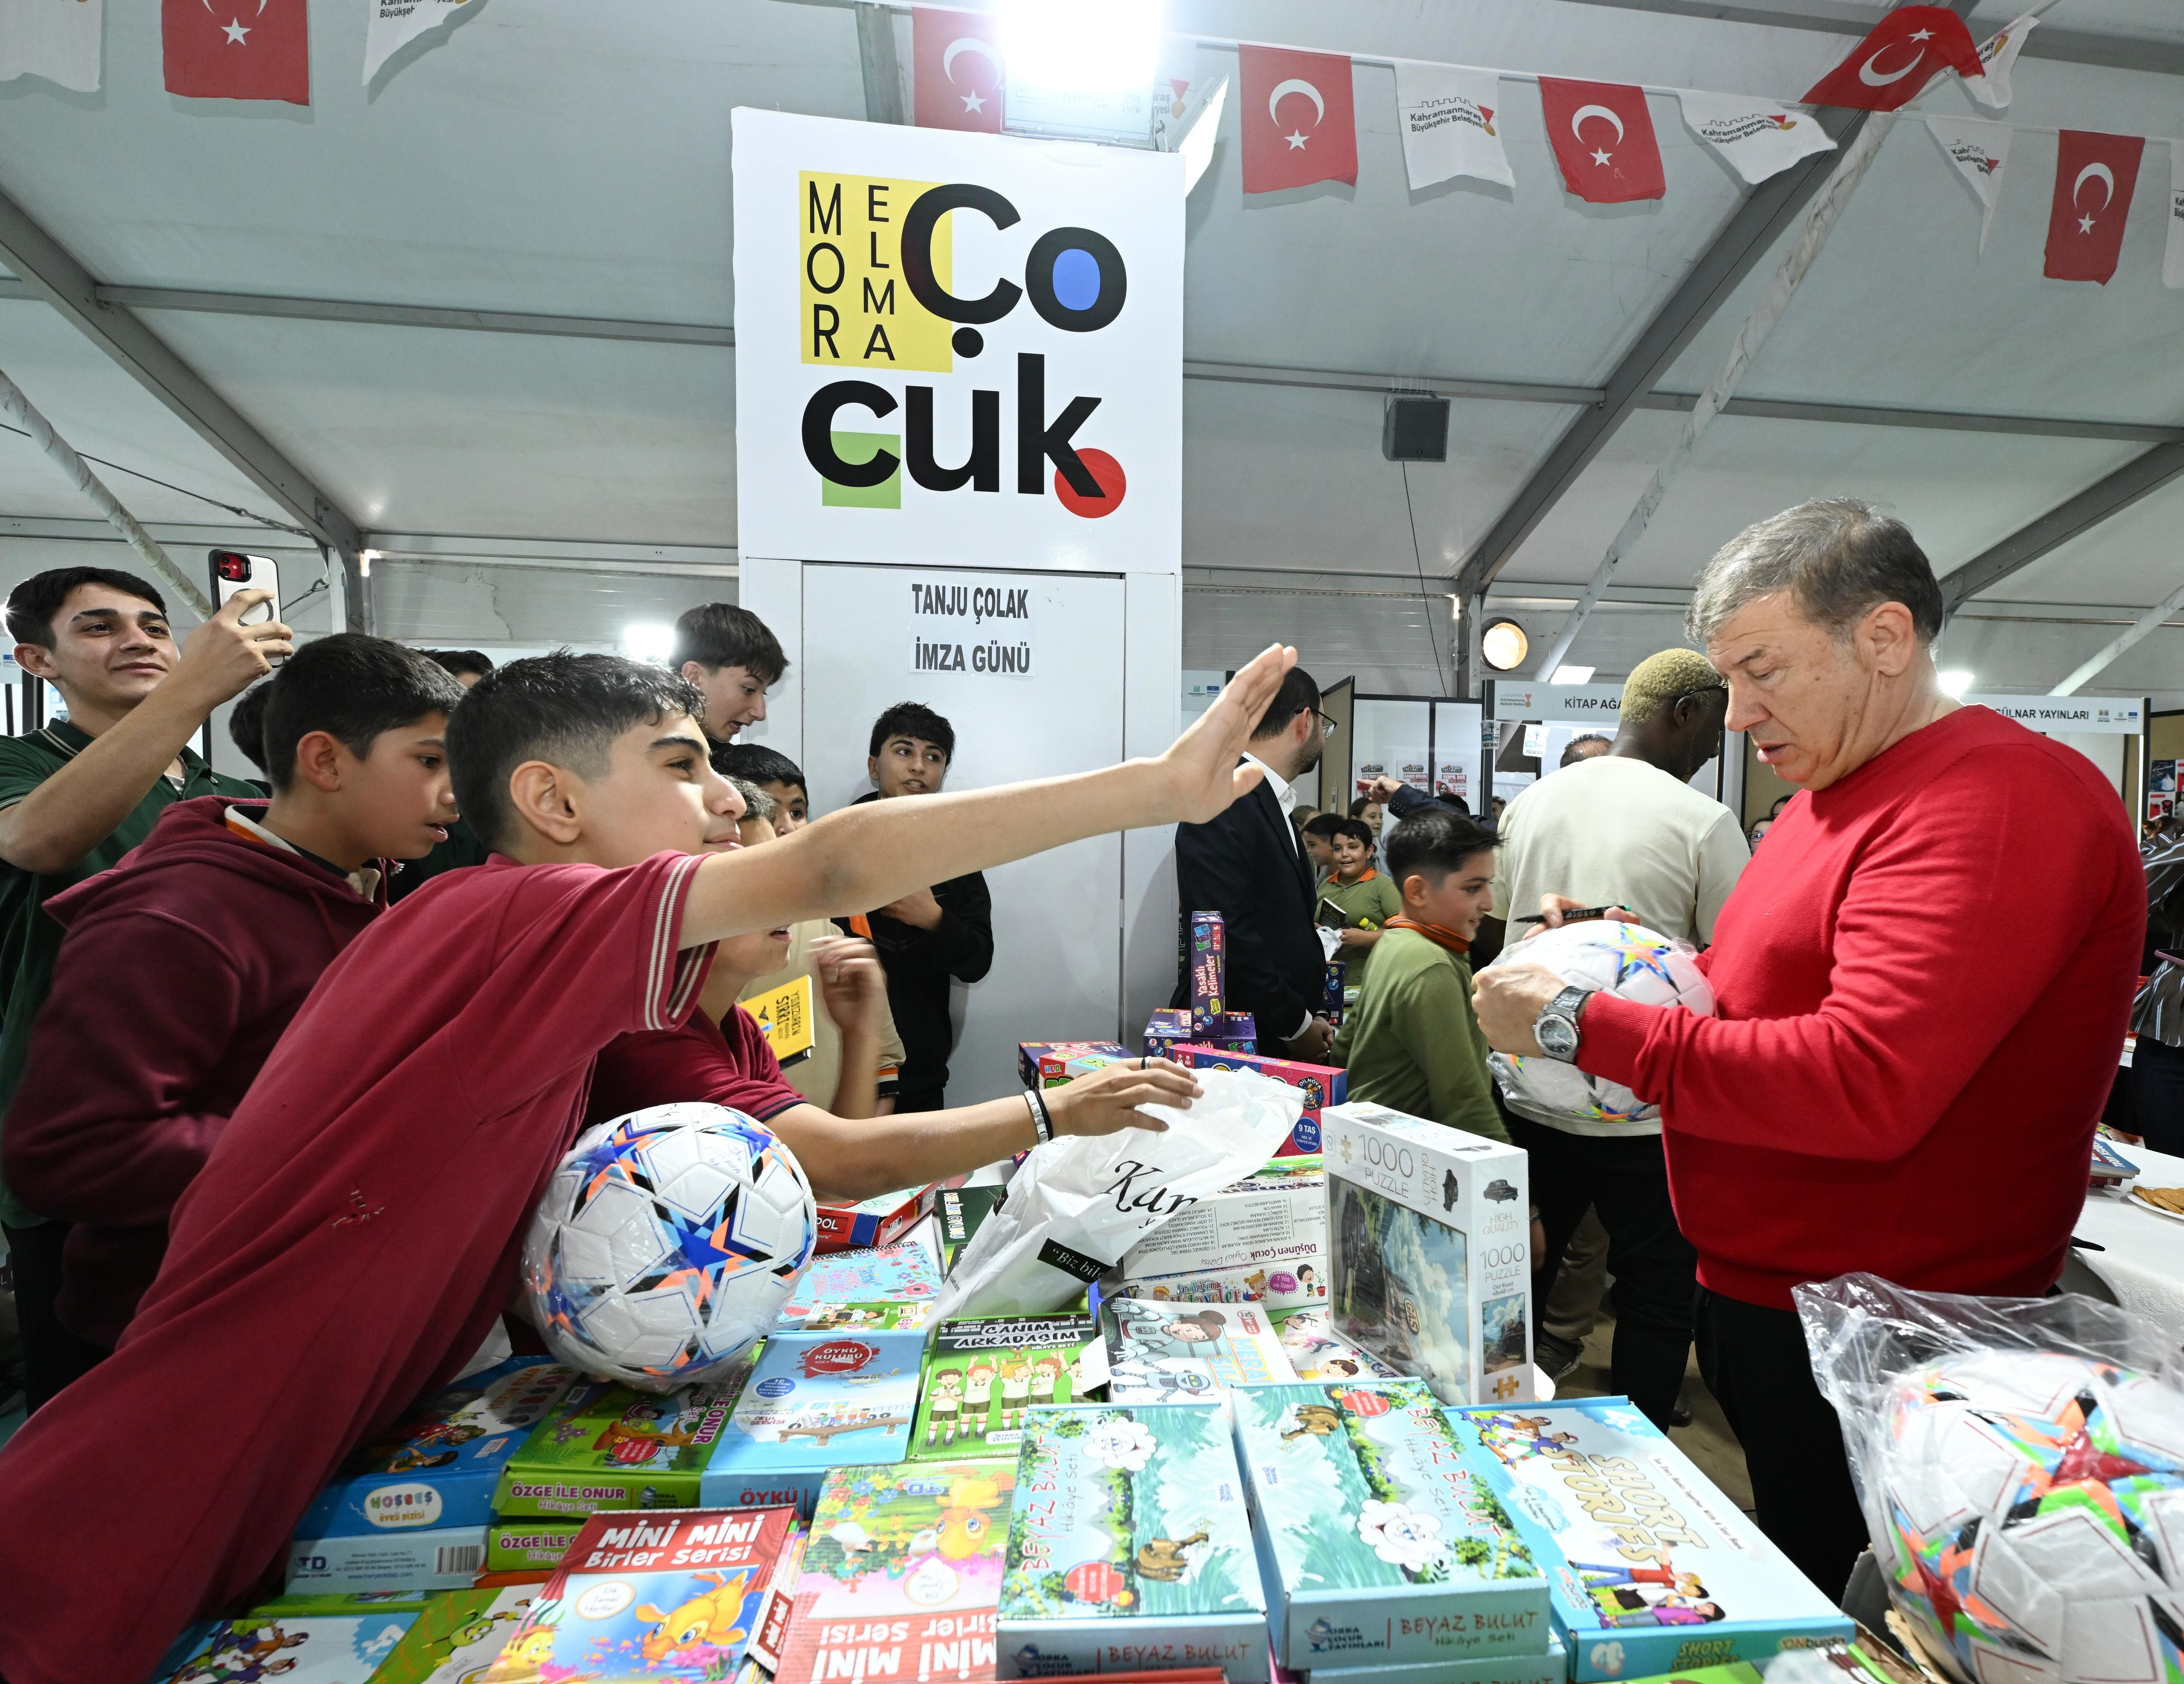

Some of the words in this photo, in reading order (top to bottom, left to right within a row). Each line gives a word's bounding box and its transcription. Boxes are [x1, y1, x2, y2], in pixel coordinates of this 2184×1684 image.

[1410, 108, 1481, 122] Kahramanmaraş
[1411, 117, 1450, 132] Büyükşehir
[1452, 115, 1483, 128] Belediyesi
[912, 584, 968, 617] TANJU
[973, 586, 1028, 625] ÇOLAK
[915, 636, 966, 671] İMZA
[972, 641, 1030, 674] GÜNÜ
[1565, 696, 1597, 709] KİTAP
[1995, 707, 2036, 718] GÜLNAR
[2039, 710, 2089, 720] YAYINLARI
[1195, 966, 1208, 997] Yasaklı
[1205, 954, 1219, 996] Kelimeler
[776, 995, 790, 1026] SIRRI
[1298, 1078, 1321, 1090] DILNOYA
[1304, 1125, 1316, 1136] TAŞ
[1358, 1133, 1414, 1178] 1000
[1365, 1166, 1409, 1199] PUZZLE
[1421, 1152, 1432, 1210] QUALITY
[944, 1192, 964, 1215] KELİME
[1490, 1212, 1513, 1223] HIGH
[947, 1215, 966, 1239] OYUNU
[1482, 1220, 1520, 1235] QUALITY
[1225, 1251, 1247, 1261] Öykü
[1250, 1247, 1276, 1260] Çocuk
[1278, 1243, 1317, 1254] Düşünen
[1480, 1243, 1525, 1270] 1000
[1201, 1257, 1223, 1266] Dizisi
[1484, 1265, 1522, 1283] PUZZLE
[984, 1322, 1051, 1335] CANIM
[958, 1331, 1077, 1347] ARKADAŞIM
[690, 1408, 727, 1445] ONUR
[1029, 1435, 1061, 1492] BULUT
[1404, 1439, 1432, 1480] Hikâye
[1406, 1407, 1460, 1466] BEYAZ
[1442, 1469, 1503, 1538] BULUT
[370, 1491, 433, 1509] HOŞBEŞ
[512, 1482, 552, 1497] ÖZGE
[555, 1483, 578, 1498] İLE
[581, 1487, 626, 1500] ONUR
[740, 1489, 798, 1505] ÖYKÜ
[1061, 1486, 1083, 1531] Hikâye
[1541, 1446, 1662, 1566] STORIES
[1588, 1454, 1709, 1550] SHORT
[379, 1512, 400, 1522] ÖYKÜ
[500, 1533, 540, 1548] ÖZGE
[543, 1532, 566, 1547] İLE
[1021, 1499, 1068, 1571] BEYAZ
[584, 1550, 665, 1568] Birler
[1400, 1615, 1467, 1640] BEYAZ
[1474, 1611, 1539, 1630] BULUT
[1108, 1645, 1177, 1664] BEYAZ
[1184, 1643, 1251, 1661] BULUT
[1680, 1639, 1734, 1656] SHORT
